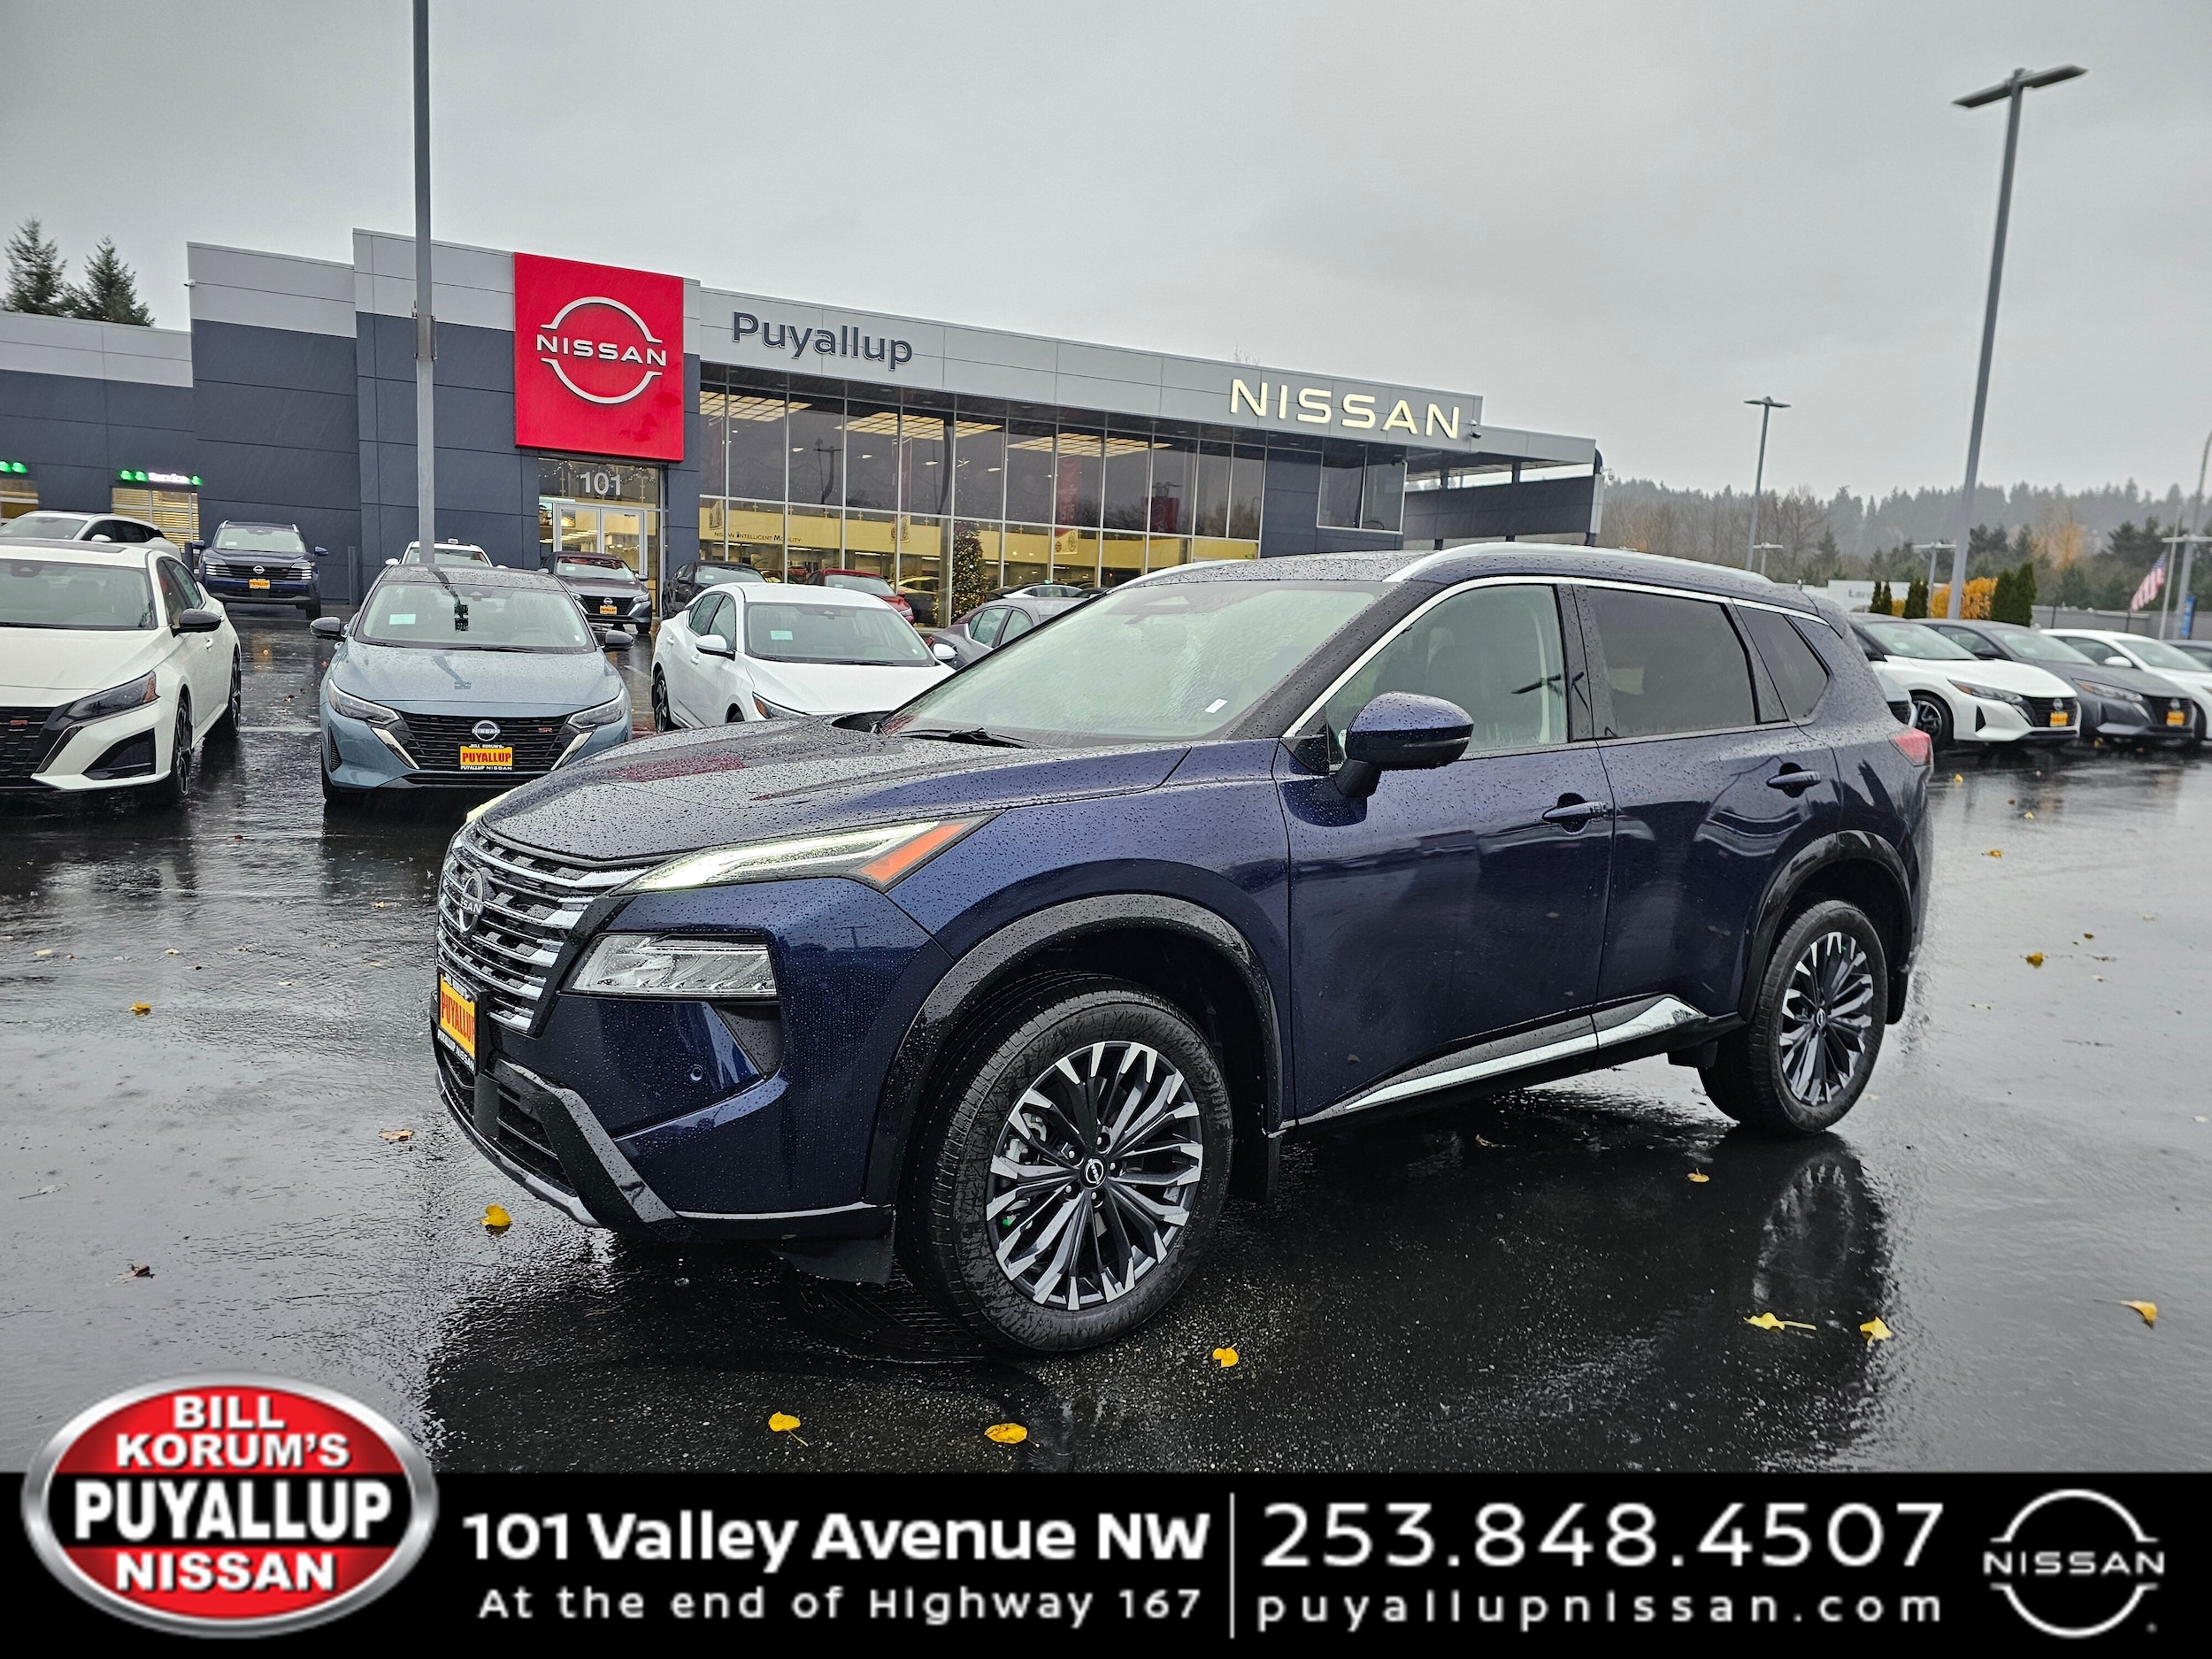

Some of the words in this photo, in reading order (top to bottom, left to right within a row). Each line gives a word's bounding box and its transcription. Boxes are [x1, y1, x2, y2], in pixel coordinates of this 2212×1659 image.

[536, 334, 667, 366] NISSAN
[732, 311, 912, 371] Puyallup
[1230, 379, 1460, 440] NISSAN
[580, 472, 621, 495] 101
[462, 752, 511, 763] PUYALLUP
